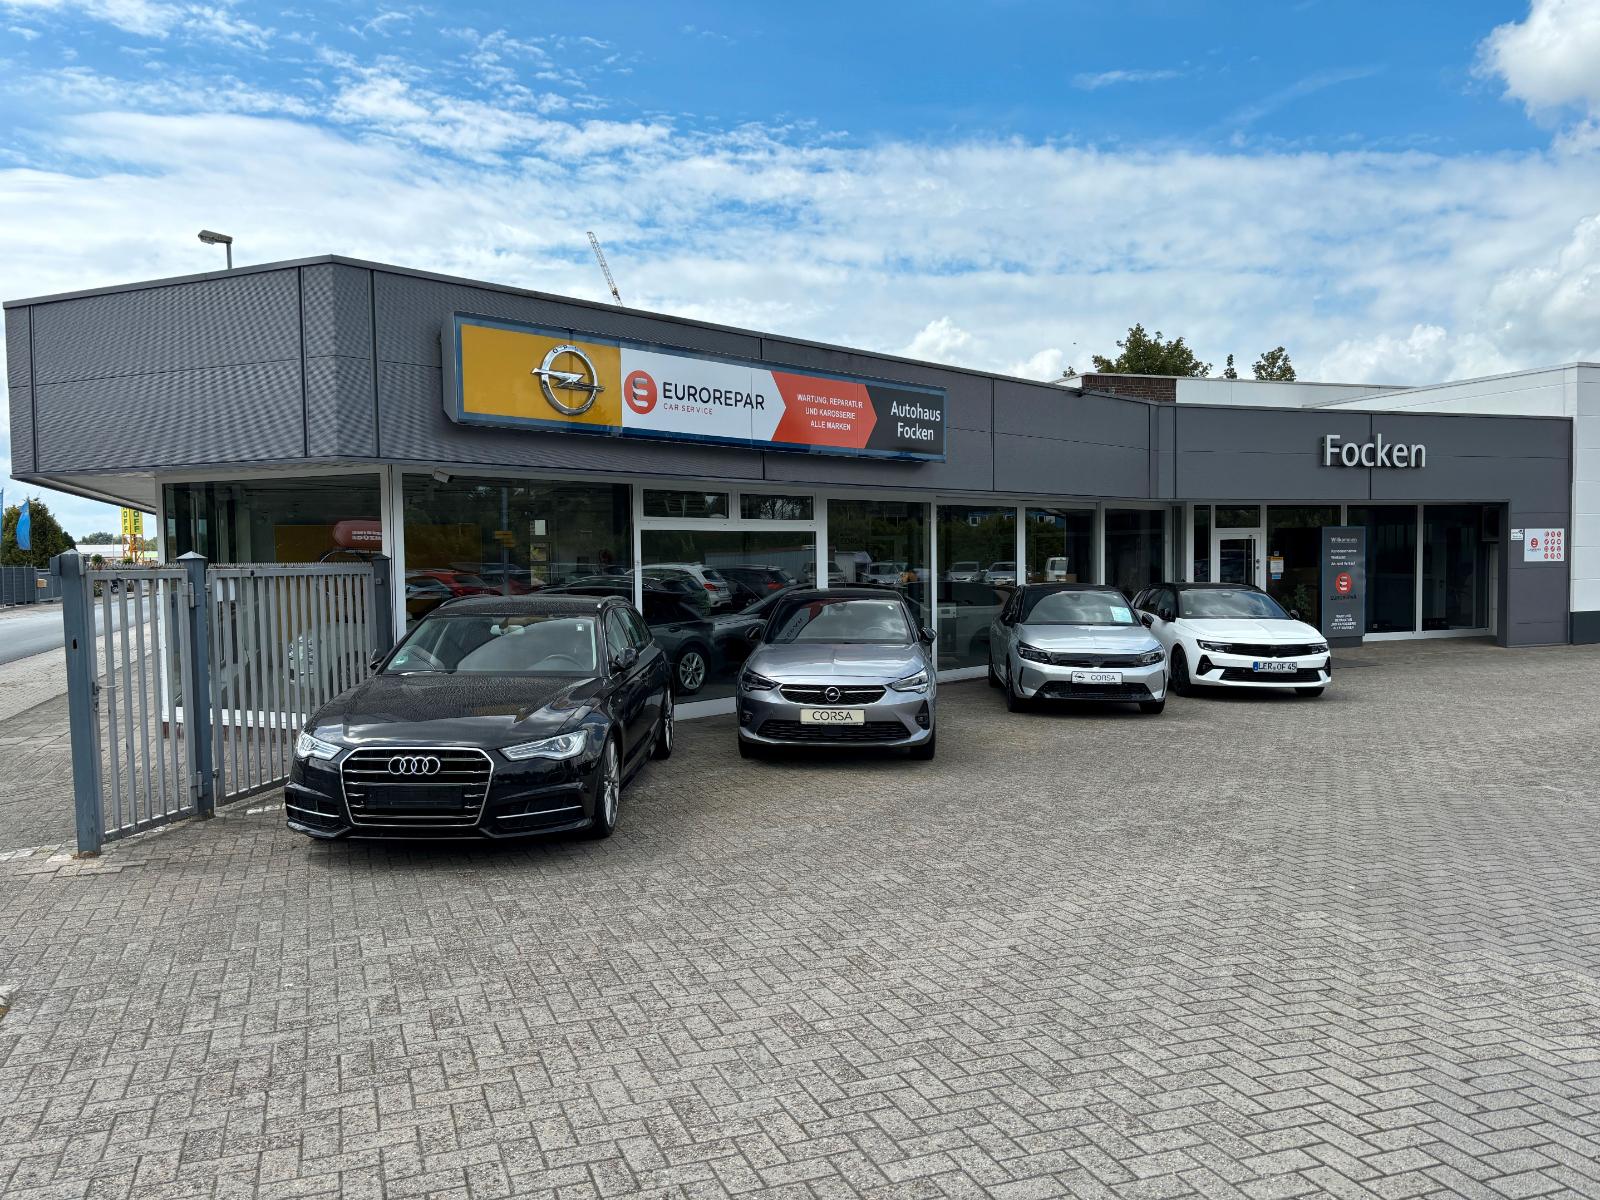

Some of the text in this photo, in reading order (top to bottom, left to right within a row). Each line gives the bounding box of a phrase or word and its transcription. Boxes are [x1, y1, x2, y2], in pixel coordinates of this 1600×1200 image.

[662, 381, 765, 410] EUROREPAR
[663, 403, 713, 415] CAR SERVICE
[805, 407, 856, 420] UND KAROSSERIE
[890, 400, 941, 422] Autohaus
[810, 419, 851, 431] ALLE MARKEN
[897, 422, 934, 441] Focken
[1325, 432, 1426, 468] Focken
[1258, 662, 1273, 671] LER
[1090, 674, 1116, 682] CORSA
[812, 710, 853, 721] CORSA
